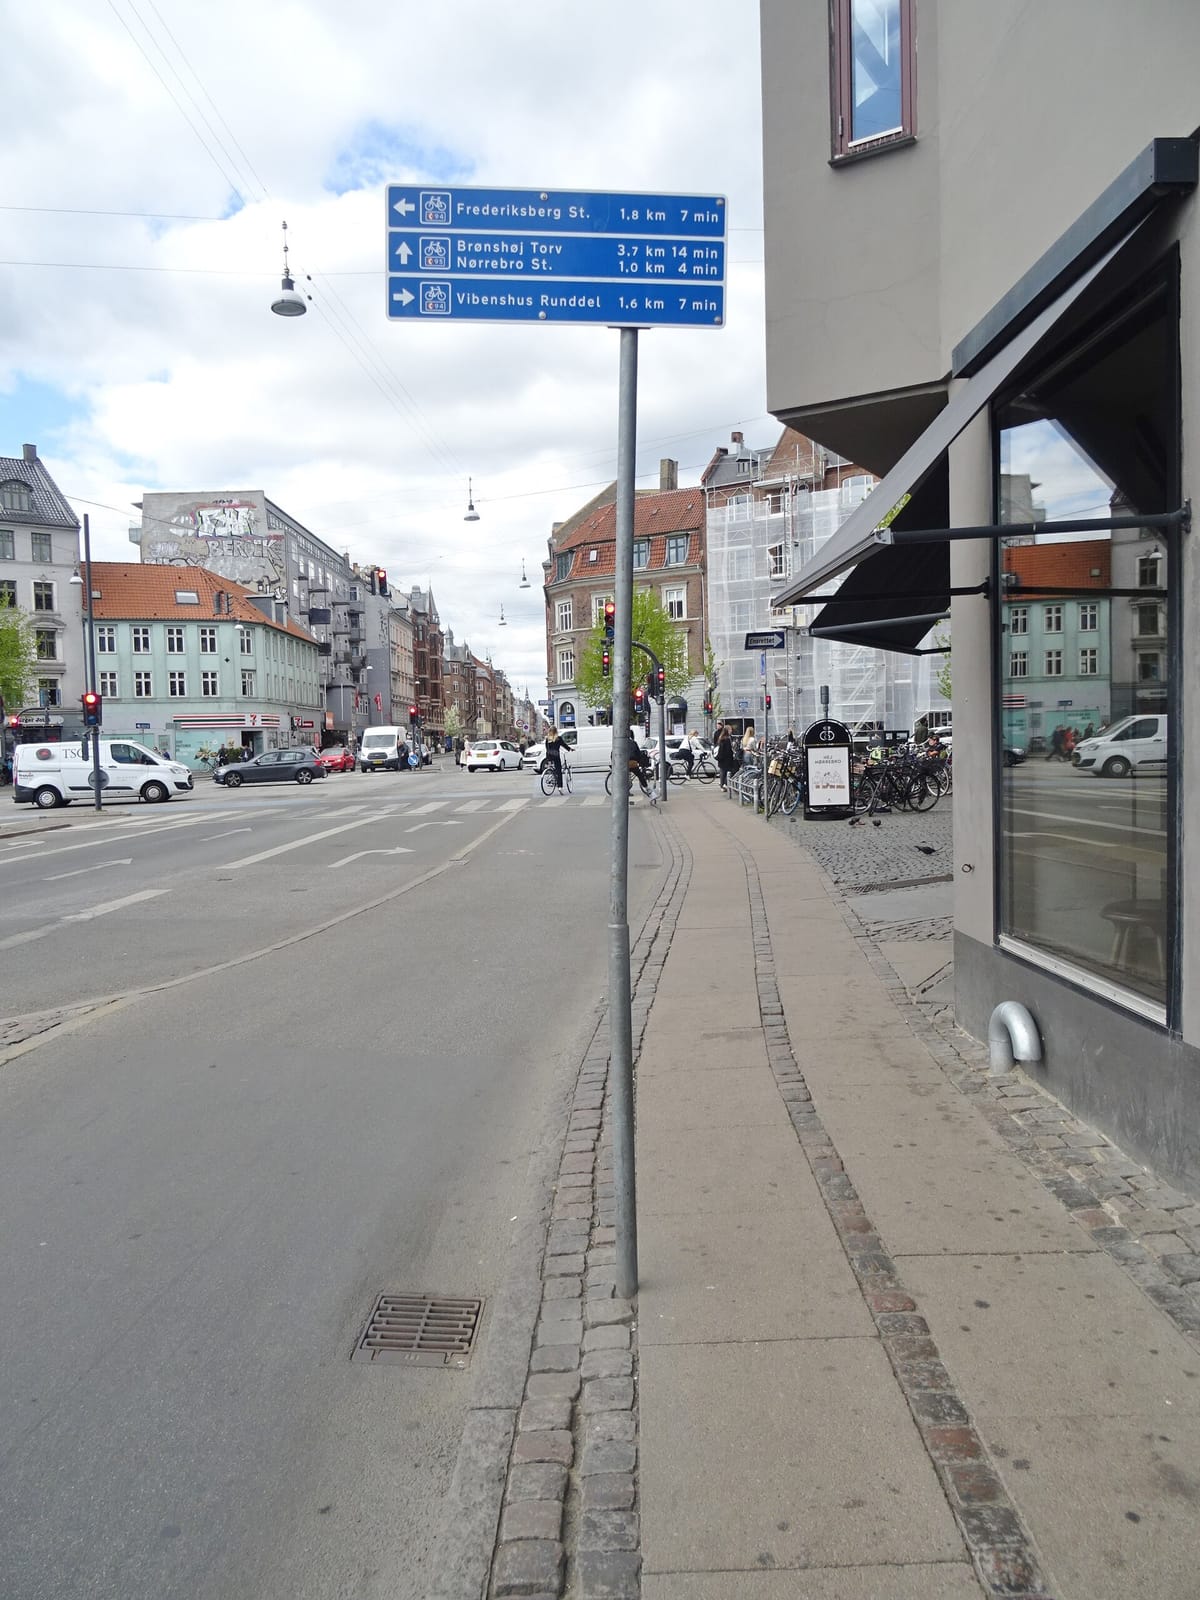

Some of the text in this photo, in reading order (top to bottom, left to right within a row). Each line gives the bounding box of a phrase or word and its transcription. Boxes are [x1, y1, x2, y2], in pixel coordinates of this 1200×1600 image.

[457, 203, 561, 220] Frederiksberg
[568, 207, 590, 219] St.
[620, 209, 639, 220] 1.8
[646, 210, 666, 221] km
[680, 211, 688, 221] 7
[694, 212, 719, 223] min
[457, 240, 524, 256] Brønshøj
[530, 242, 562, 254] Torv
[617, 245, 639, 257] 3.7
[646, 246, 665, 257] km
[671, 247, 688, 258] 14
[693, 248, 718, 259] min
[457, 257, 718, 275] Nørrebro St. 1.0 km 4 min
[456, 293, 533, 306] Vibenshus
[540, 295, 601, 308] Runddel
[619, 297, 638, 309] 1.6
[645, 298, 664, 309] km
[679, 299, 687, 310] 7
[692, 300, 717, 311] min
